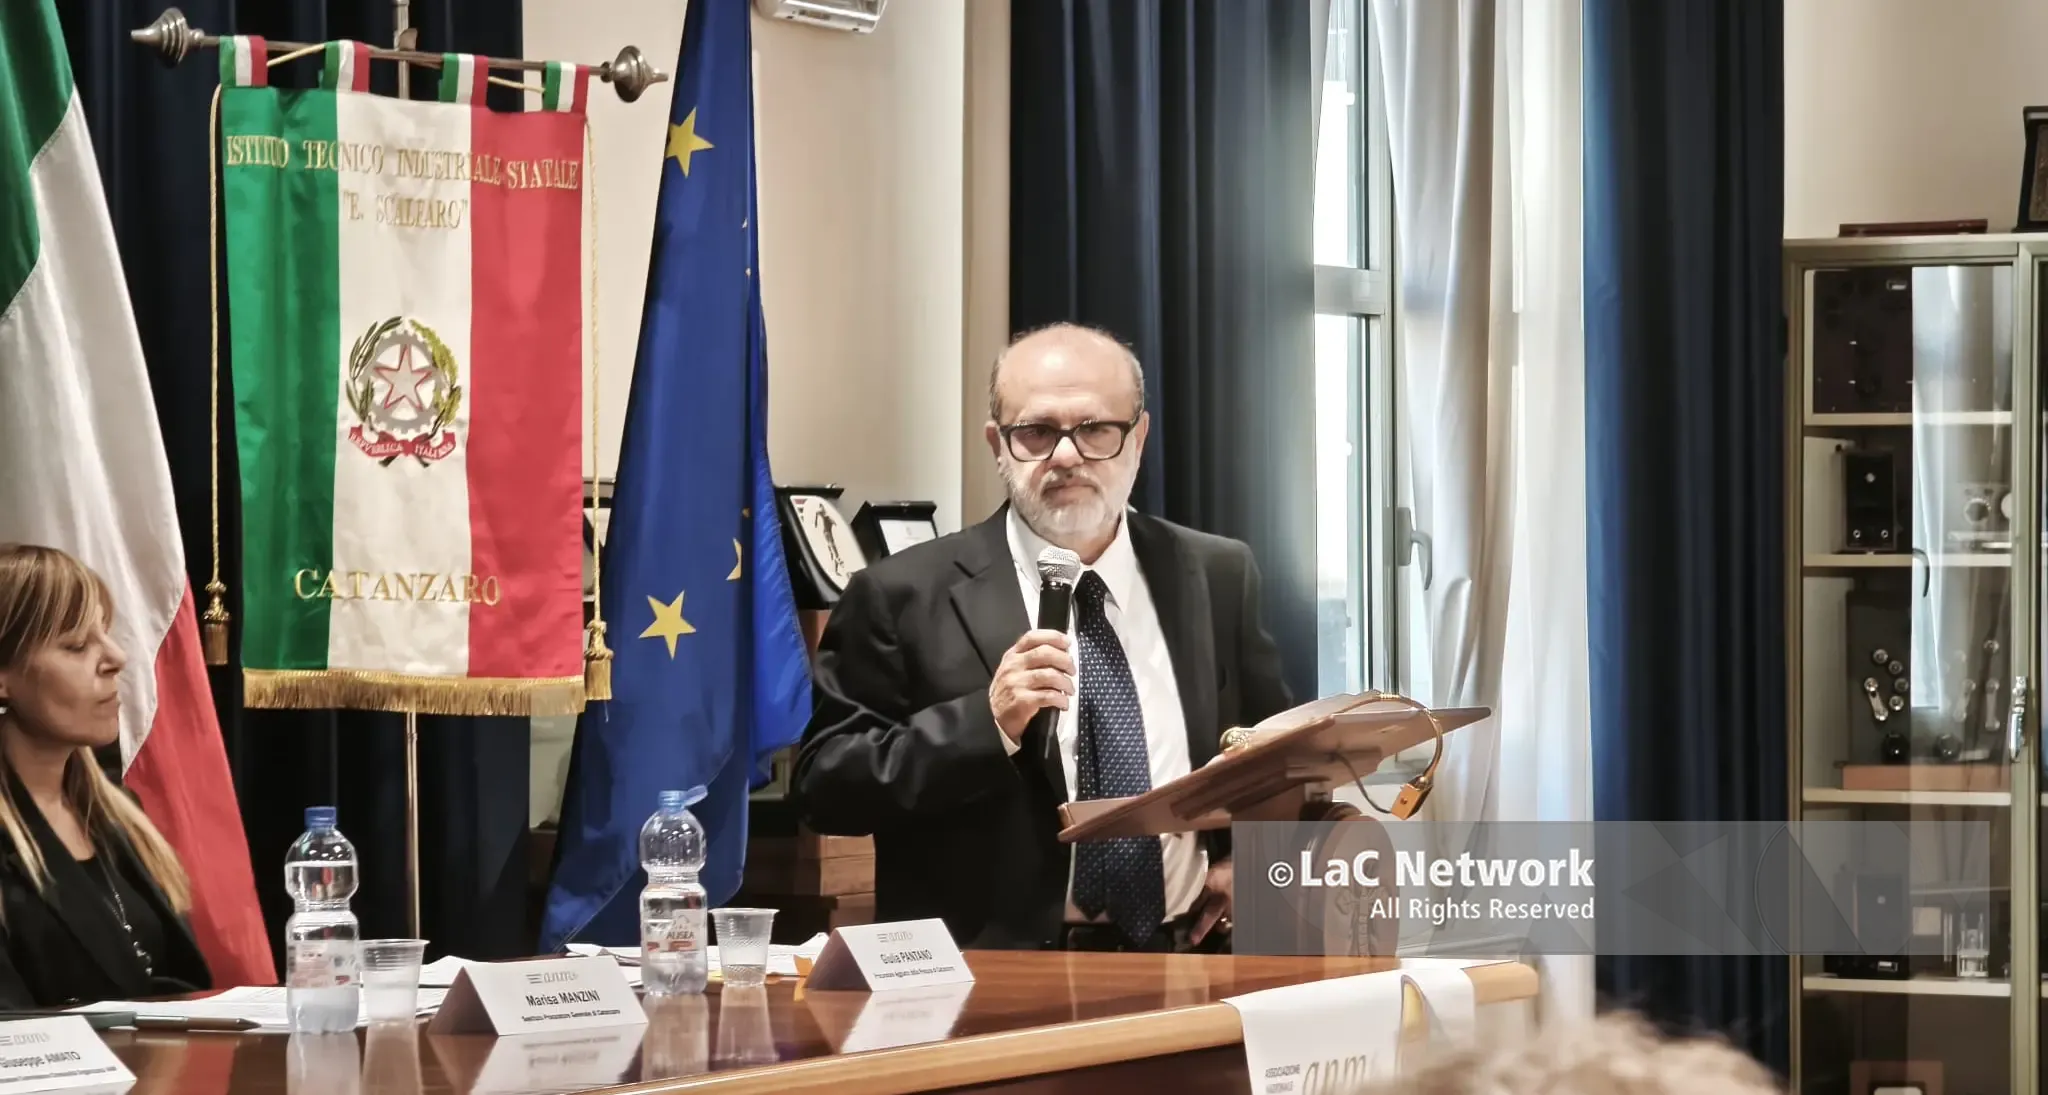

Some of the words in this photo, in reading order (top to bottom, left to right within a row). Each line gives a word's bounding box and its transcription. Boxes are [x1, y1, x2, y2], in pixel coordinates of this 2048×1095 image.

[303, 140, 384, 175] TECNICO
[396, 148, 501, 186] INDUSTRIALE
[506, 159, 580, 190] STATALE
[294, 568, 501, 606] CATANZARO
[900, 949, 933, 963] PANTANO
[525, 995, 560, 1007] Marisa
[558, 990, 601, 1004] MANZINI
[44, 1051, 81, 1064] AMATO
